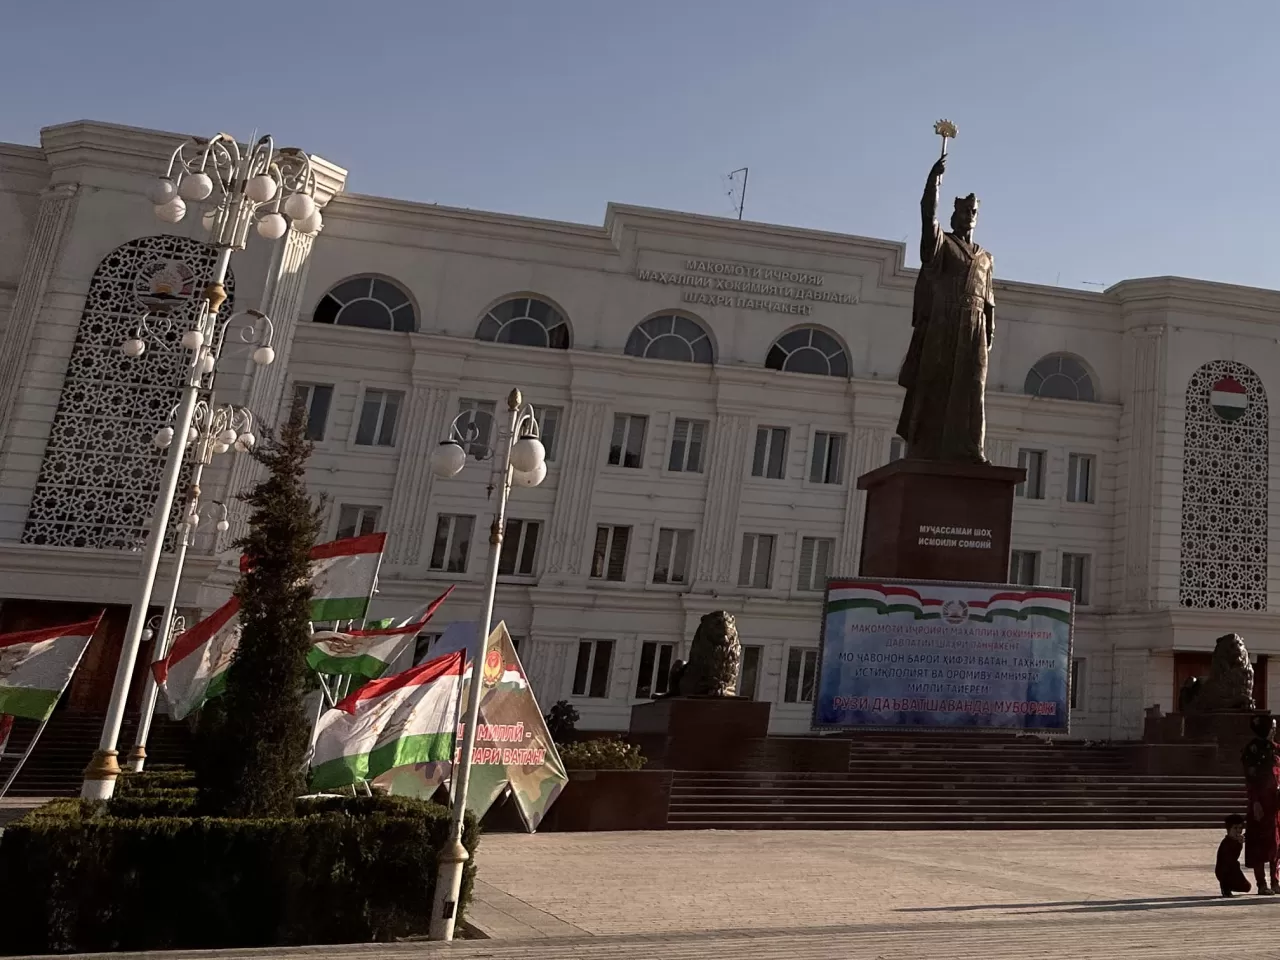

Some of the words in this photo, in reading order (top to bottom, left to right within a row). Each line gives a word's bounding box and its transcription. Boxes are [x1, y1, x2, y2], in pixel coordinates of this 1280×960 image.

[918, 537, 957, 547] ИСМОИЛИ
[838, 652, 854, 662] МО
[931, 670, 945, 679] ВА
[502, 748, 547, 765] ВАТАН!
